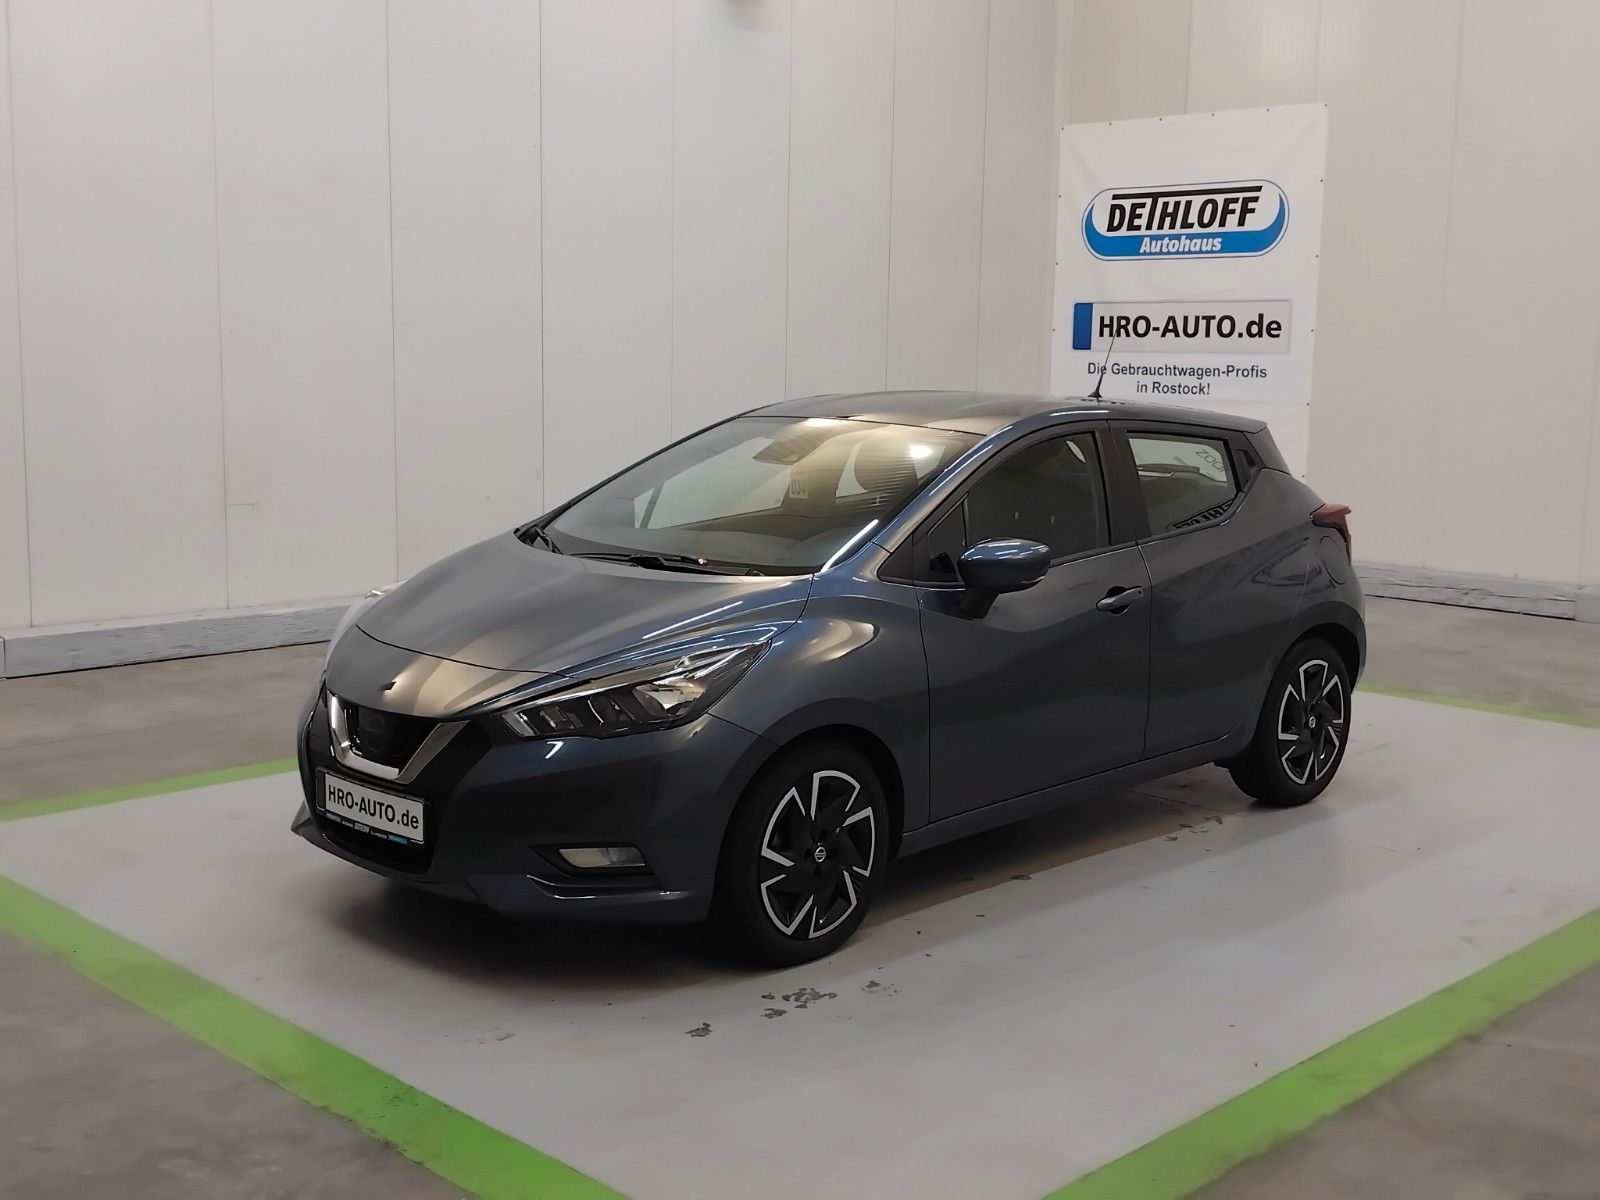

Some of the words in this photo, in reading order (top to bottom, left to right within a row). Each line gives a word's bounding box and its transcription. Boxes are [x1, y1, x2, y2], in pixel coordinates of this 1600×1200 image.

[1106, 185, 1263, 233] DETHLOFF
[1139, 236, 1222, 253] Autohaus
[1099, 313, 1283, 339] HRO-AUTO.de
[1088, 363, 1107, 375] Die
[1111, 363, 1267, 379] Gebrauchtwagen-Profis
[1136, 382, 1148, 393] in
[1152, 382, 1211, 395] Rostock!
[328, 785, 419, 830] HRO-AUTO.de
